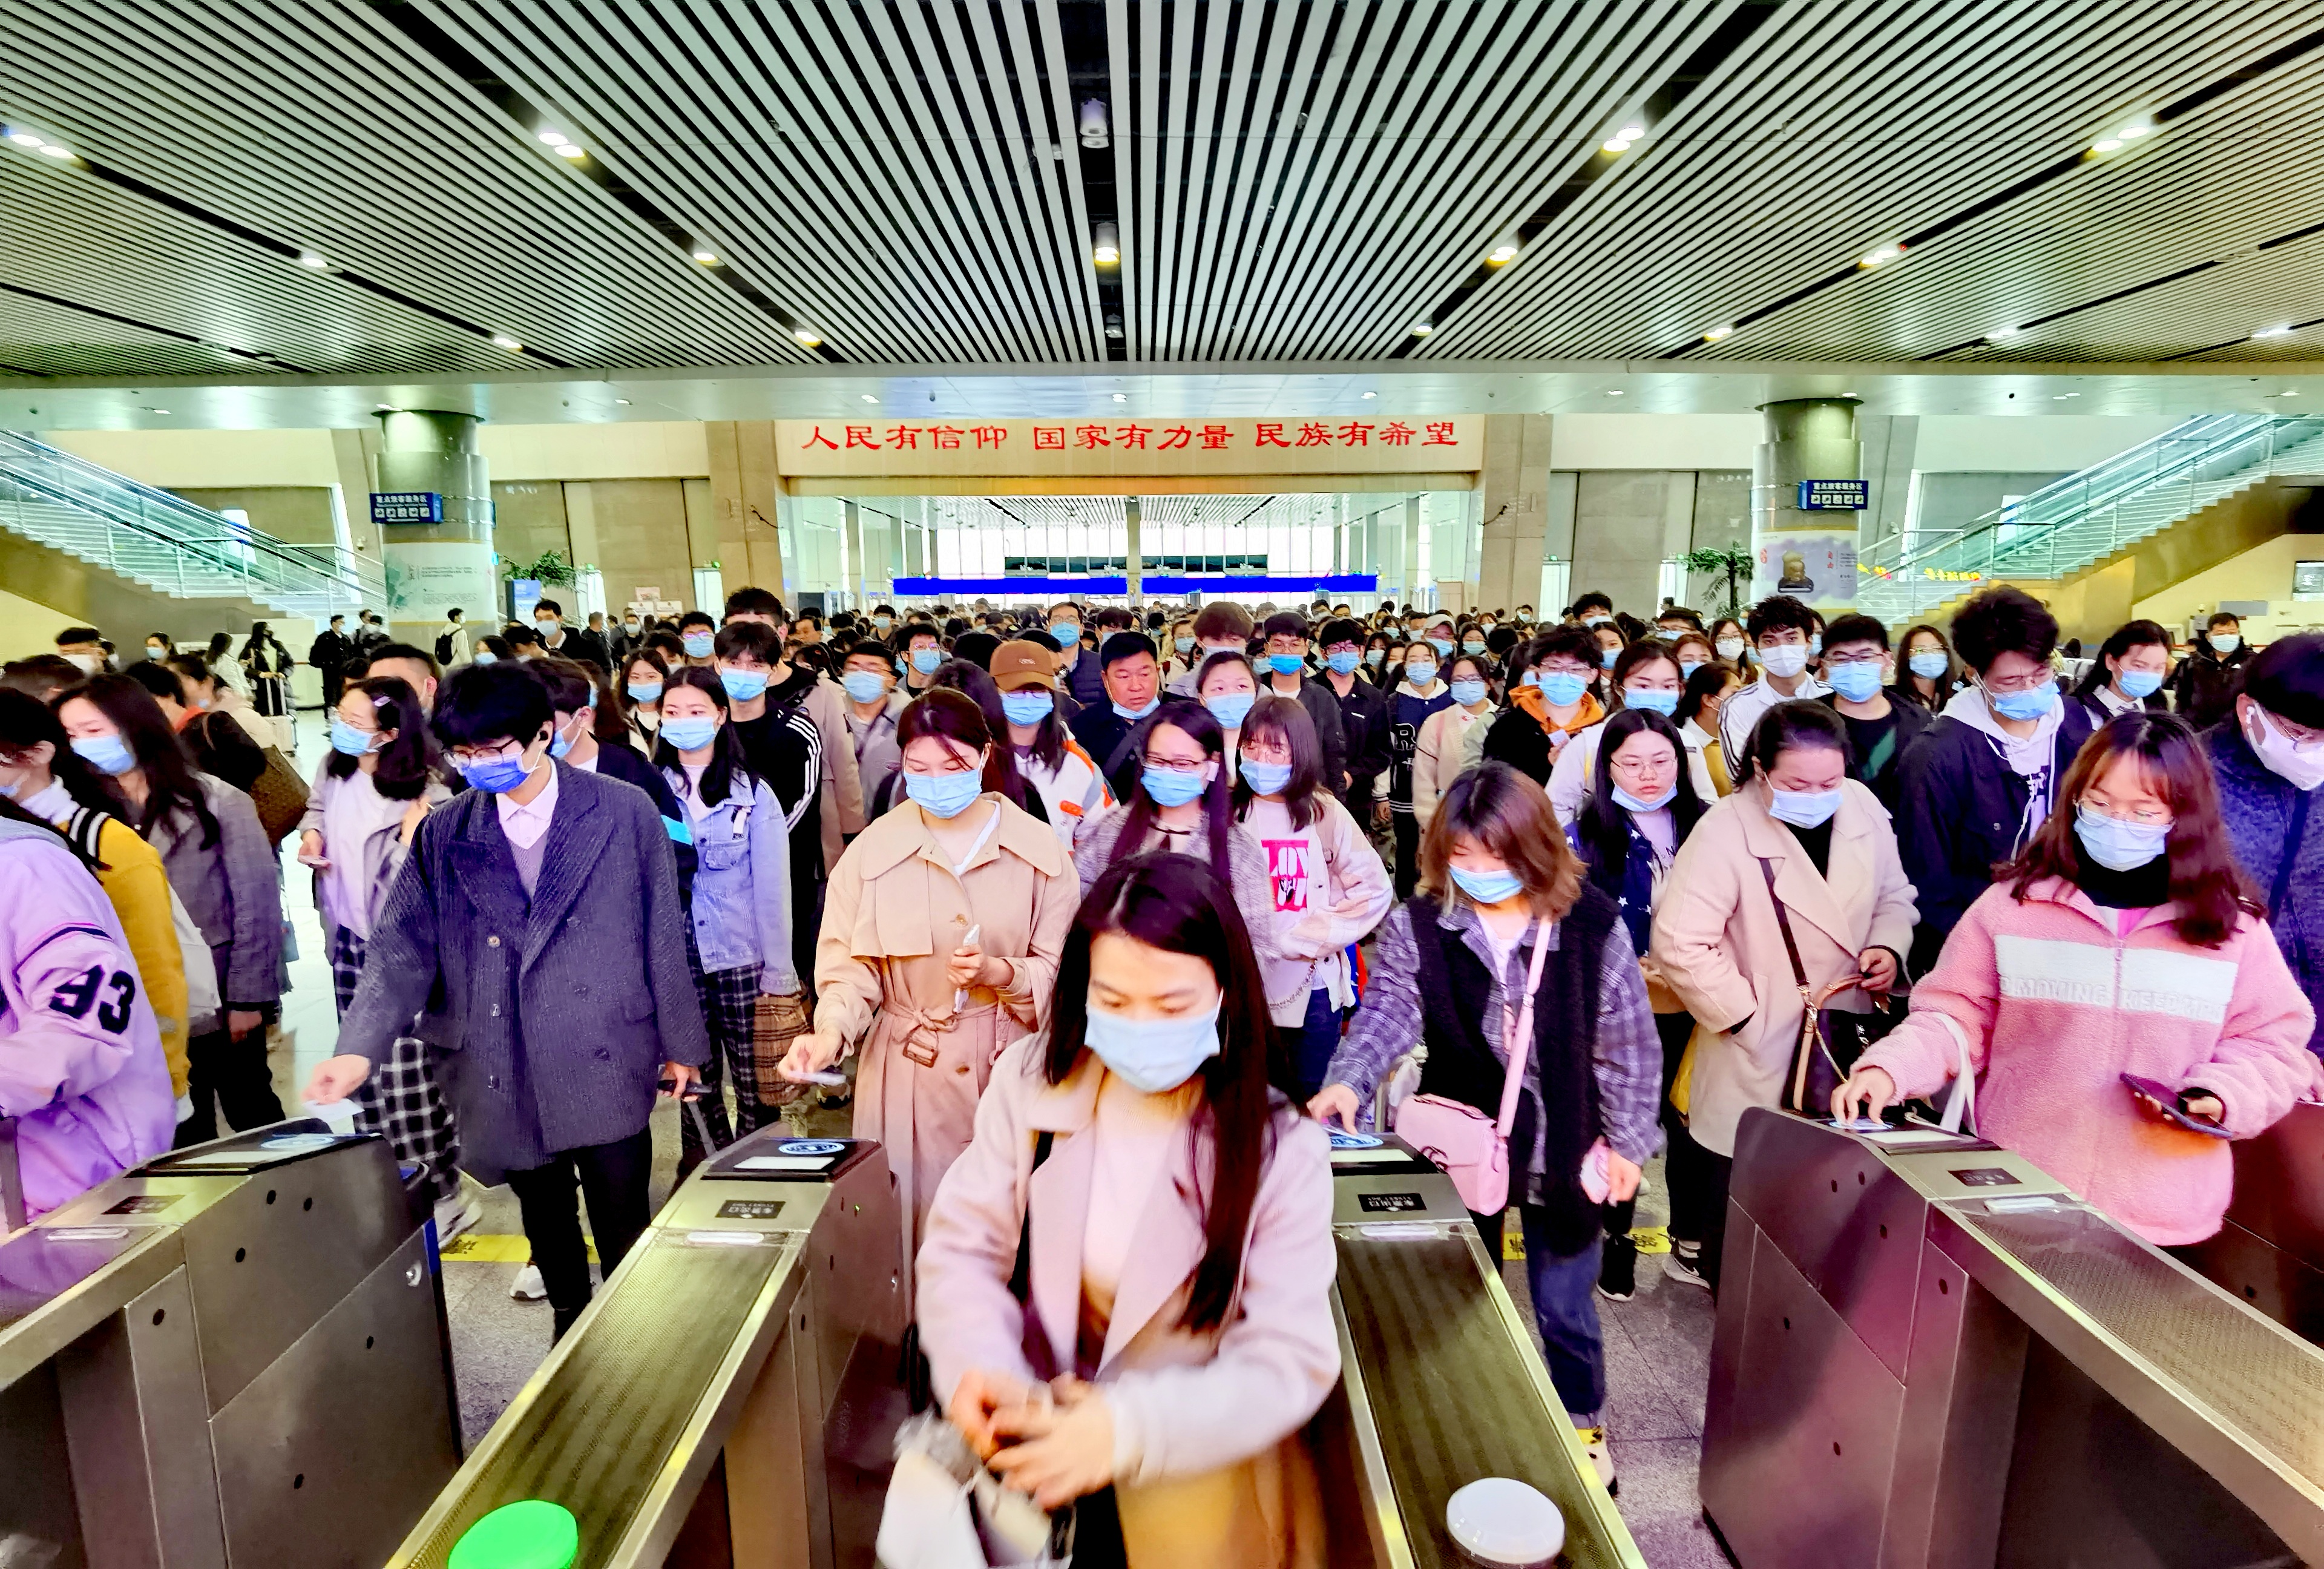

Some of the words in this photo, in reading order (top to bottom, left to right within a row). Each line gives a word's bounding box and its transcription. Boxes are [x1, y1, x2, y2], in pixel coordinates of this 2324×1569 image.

[801, 424, 1008, 450] 人民有信仰
[1033, 423, 1235, 450] 国家有力量
[1255, 421, 1459, 448] 民族有希望
[48, 964, 136, 1035] 93
